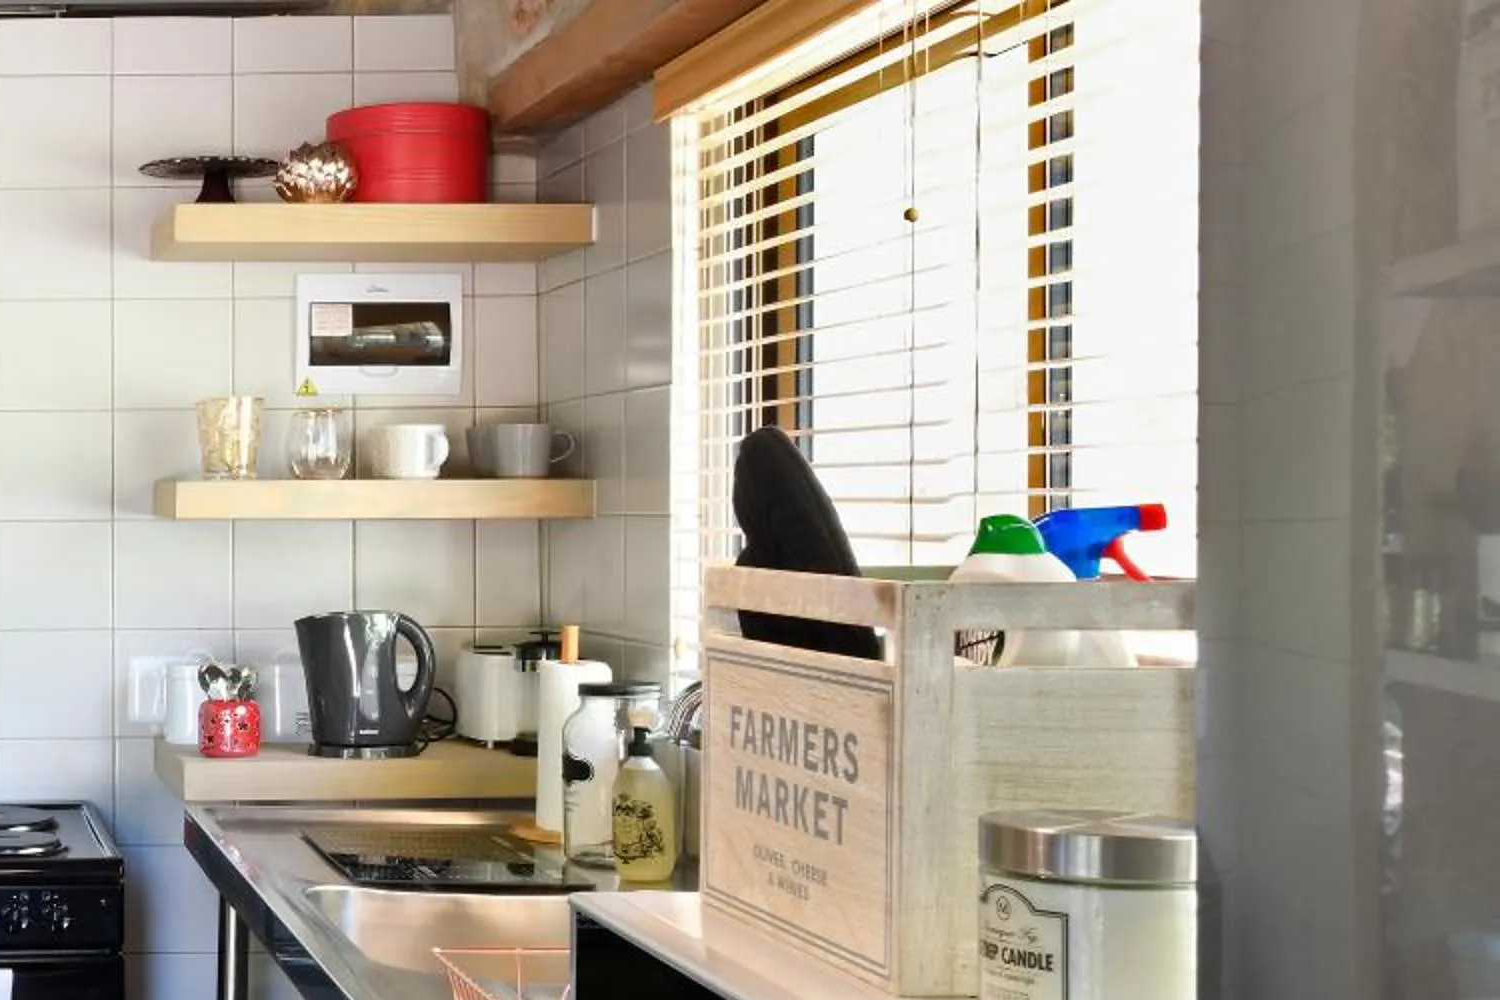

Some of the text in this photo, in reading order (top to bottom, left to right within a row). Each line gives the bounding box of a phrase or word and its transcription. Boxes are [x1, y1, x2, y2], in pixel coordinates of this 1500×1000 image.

[729, 704, 859, 785] FARMERS
[735, 765, 849, 846] MARKET
[1001, 946, 1055, 972] CANDLE
